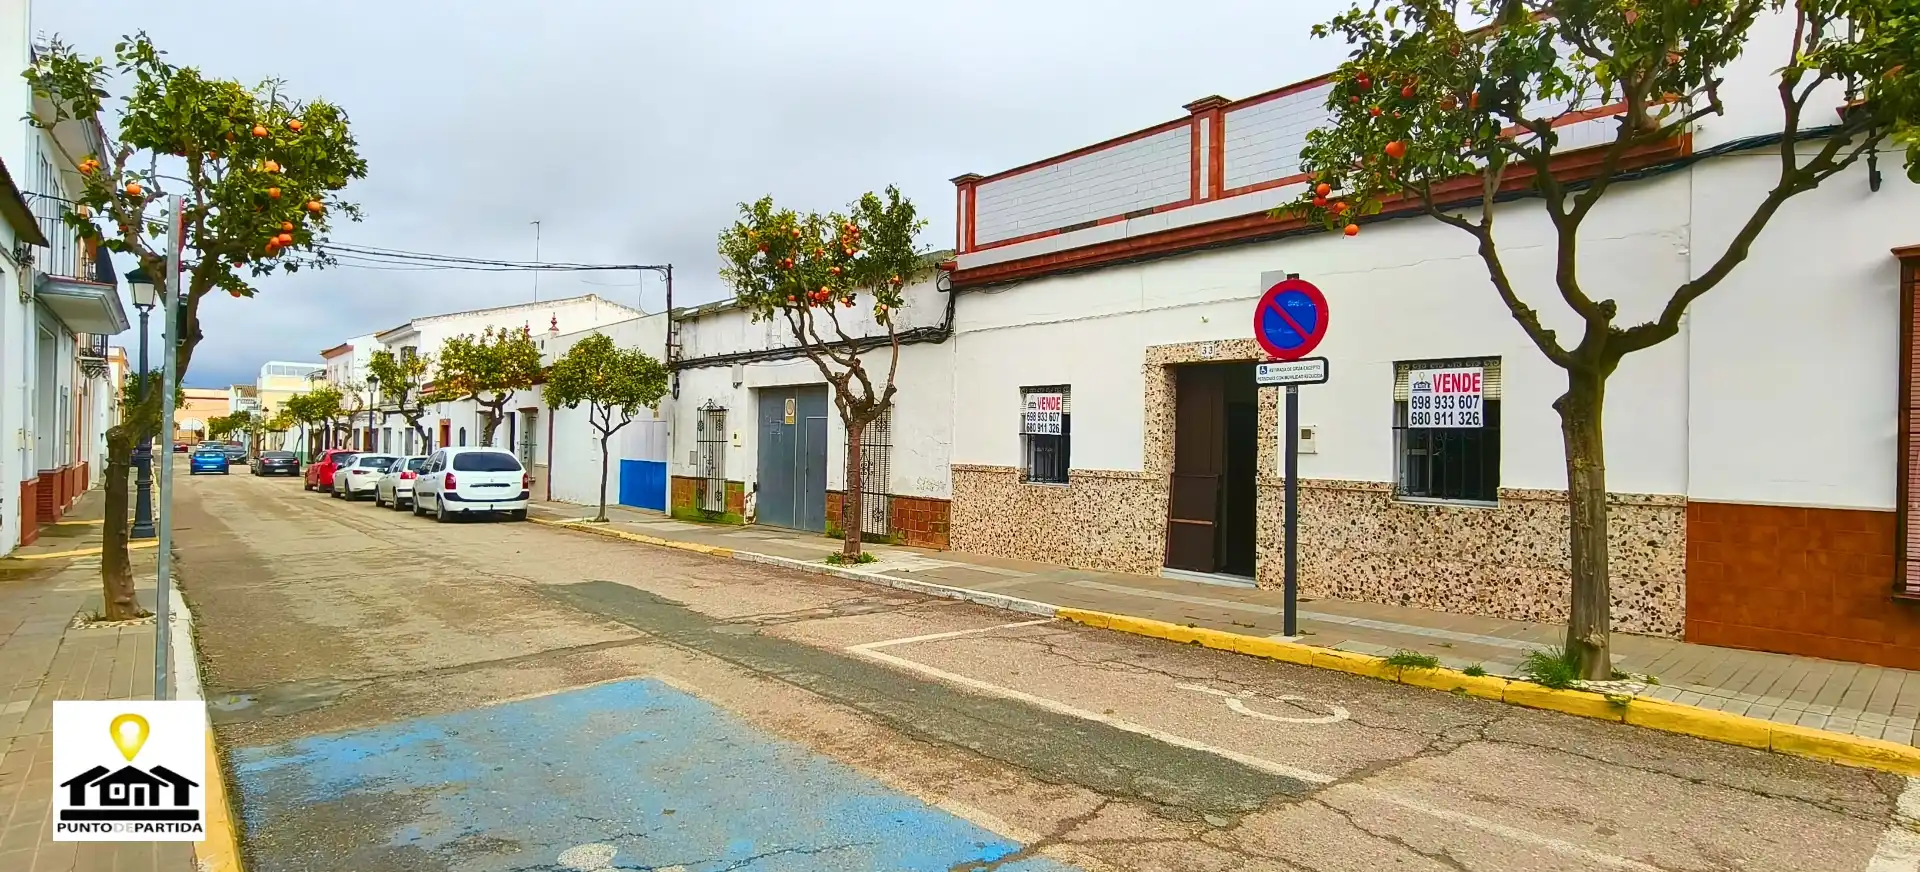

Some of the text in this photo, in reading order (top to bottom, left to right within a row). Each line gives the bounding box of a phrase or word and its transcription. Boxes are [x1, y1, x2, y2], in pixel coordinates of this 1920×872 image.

[1202, 346, 1213, 355] 33
[1432, 372, 1480, 393] VENDE
[1037, 396, 1060, 410] VENDE
[1412, 394, 1480, 410] 698 933 607
[1026, 412, 1060, 422] 698 933 607
[1411, 412, 1480, 425] 680 911 326
[1026, 422, 1060, 433] 680 911 326
